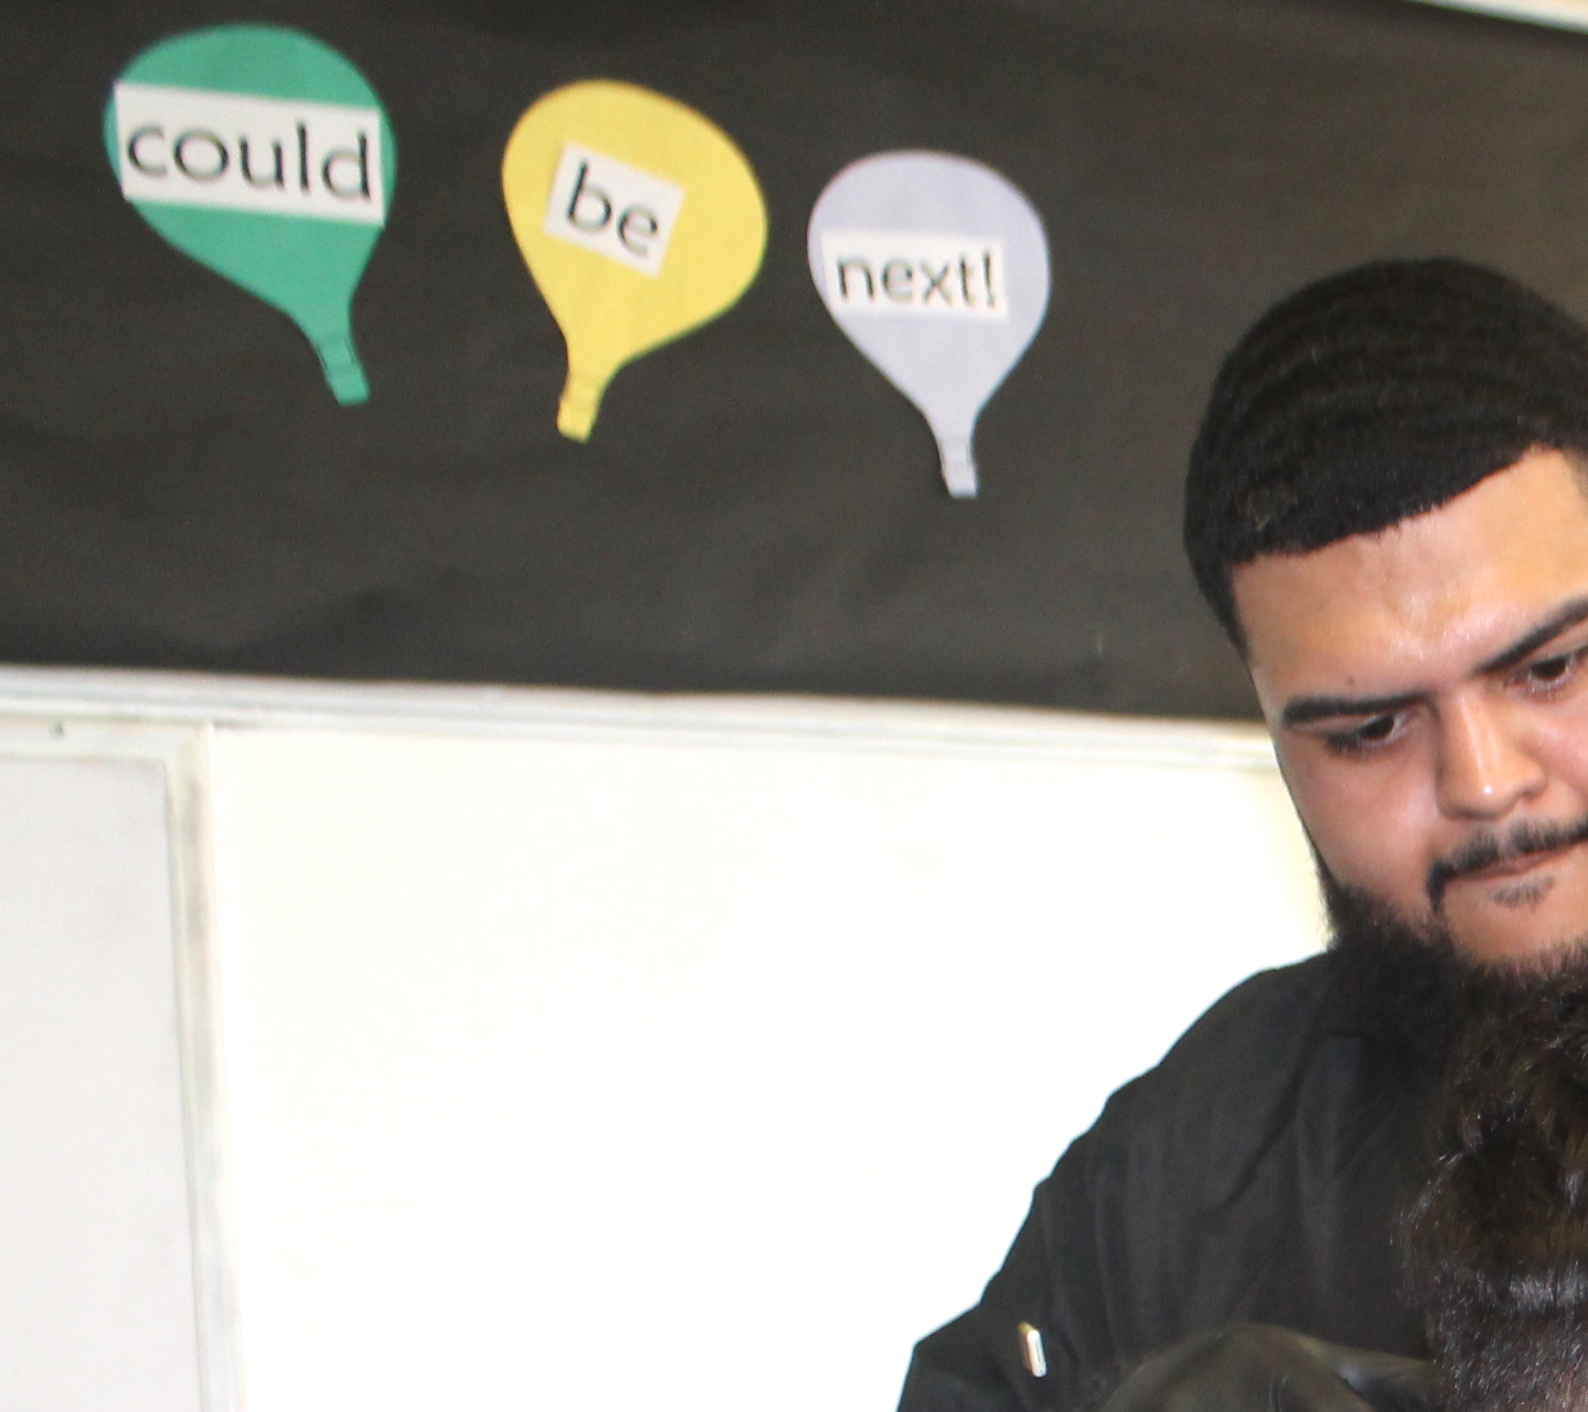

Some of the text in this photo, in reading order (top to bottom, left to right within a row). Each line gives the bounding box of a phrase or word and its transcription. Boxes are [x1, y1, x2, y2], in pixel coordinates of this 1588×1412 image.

[127, 121, 998, 309] could be next!
